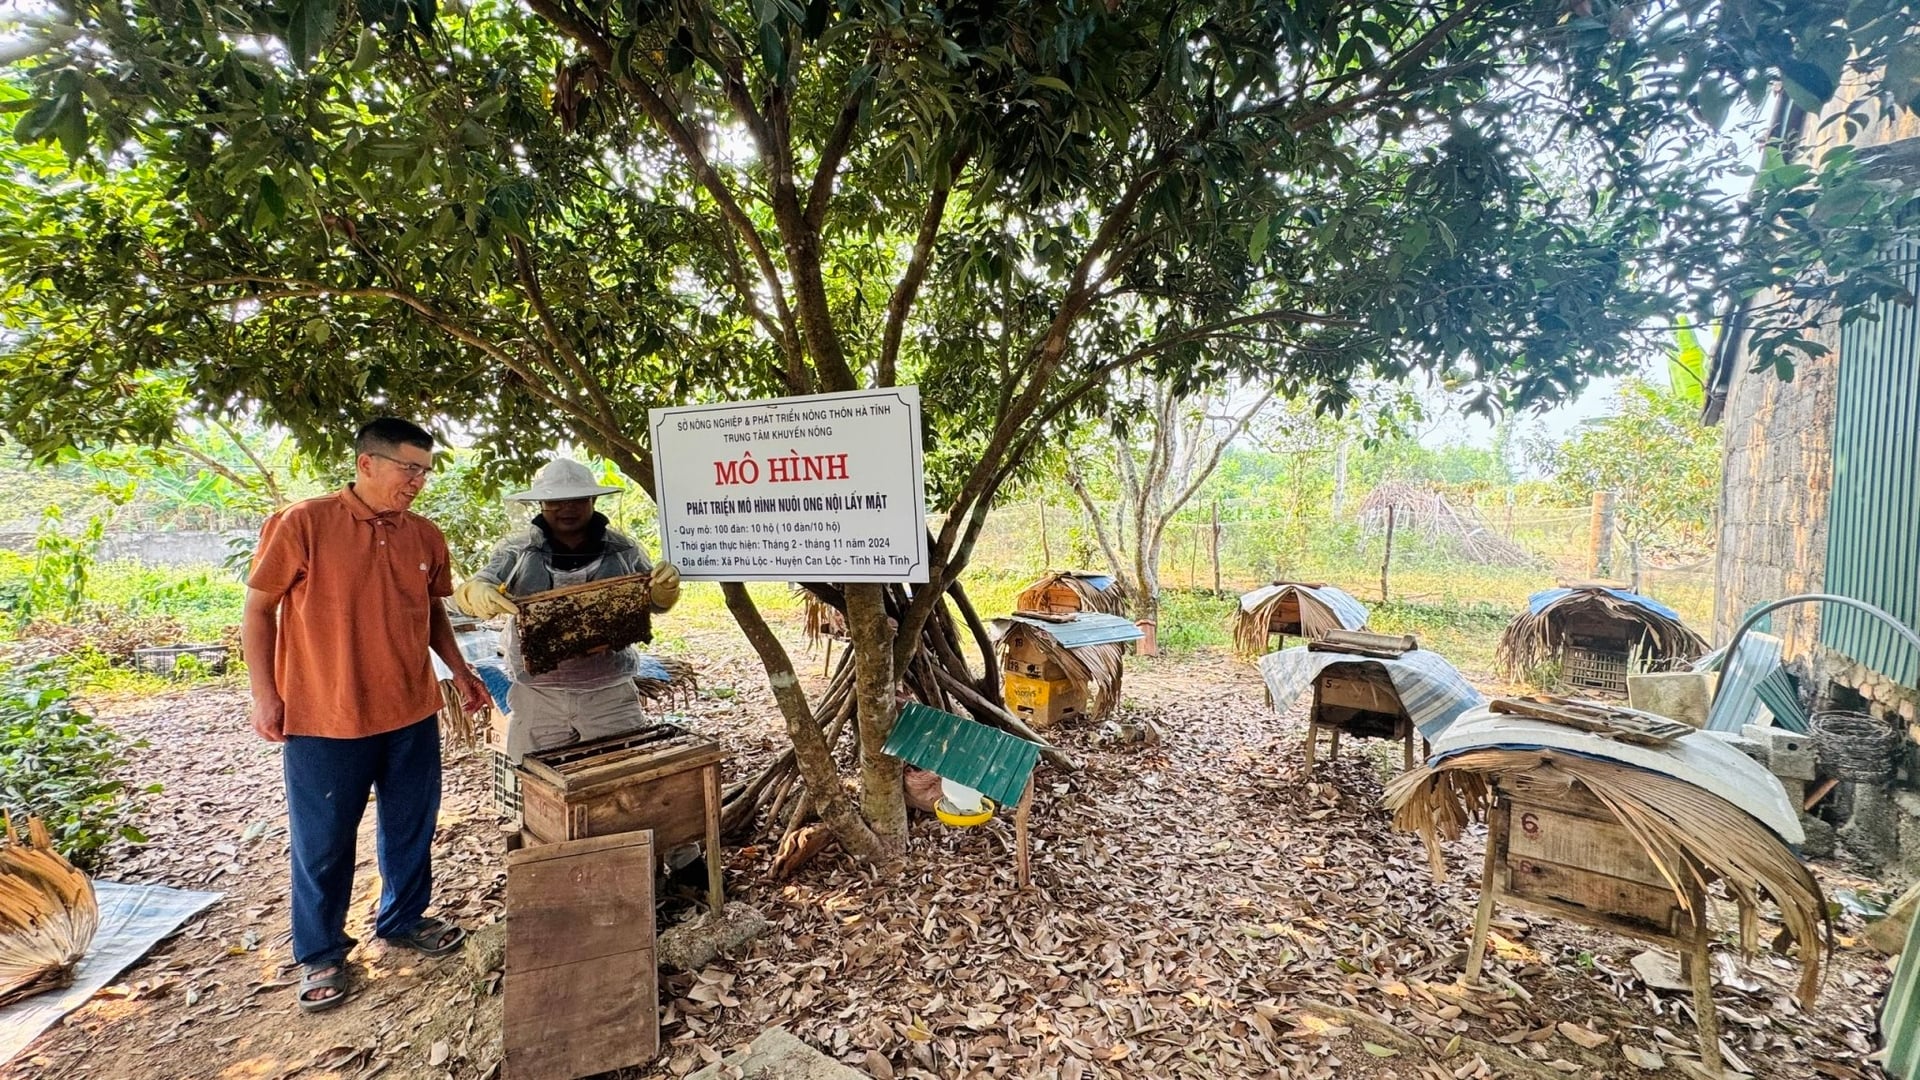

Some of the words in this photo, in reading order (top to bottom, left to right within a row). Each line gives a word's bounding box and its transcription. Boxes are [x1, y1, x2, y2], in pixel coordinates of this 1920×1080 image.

[690, 417, 712, 430] NÔNG
[745, 416, 750, 426] &
[752, 412, 774, 425] PHÁT
[776, 408, 800, 423] TRIỂN
[802, 409, 827, 421] NÔNG
[829, 406, 853, 419] THÔN
[855, 404, 868, 417] HÀ
[724, 433, 751, 443] TRUNG
[752, 429, 770, 441] TÂM
[772, 426, 806, 439] KHUYẾN
[808, 425, 833, 437] NÔNG
[713, 450, 759, 486] MÔ
[767, 448, 849, 483] HÌNH
[686, 499, 708, 515] PHÁT
[738, 496, 752, 514] MÔ
[754, 495, 776, 513] HÌNH
[778, 494, 801, 513] NUÔI
[803, 497, 823, 512] ONG
[825, 493, 842, 514] NỘI
[845, 489, 862, 510] LẤY
[865, 491, 888, 512] MẬT
[679, 525, 695, 537] Quy
[714, 524, 729, 534] 100
[751, 524, 761, 533] 10
[763, 522, 775, 534] hộ
[782, 522, 792, 533] 10
[700, 541, 717, 552] gian
[719, 539, 738, 552] thực
[762, 539, 789, 551] Tháng
[791, 539, 797, 550] 2
[804, 538, 831, 551] tháng
[833, 538, 843, 548] 11
[846, 538, 866, 548] năm
[868, 537, 890, 548] 2024
[682, 557, 696, 568] Địa
[734, 556, 750, 566] Phú
[752, 555, 768, 567] Lộc
[775, 556, 803, 568] Huyện
[805, 555, 823, 566] Can
[825, 555, 842, 567] Lộc
[873, 554, 886, 565] Hà
[1521, 812, 1539, 834] 6
